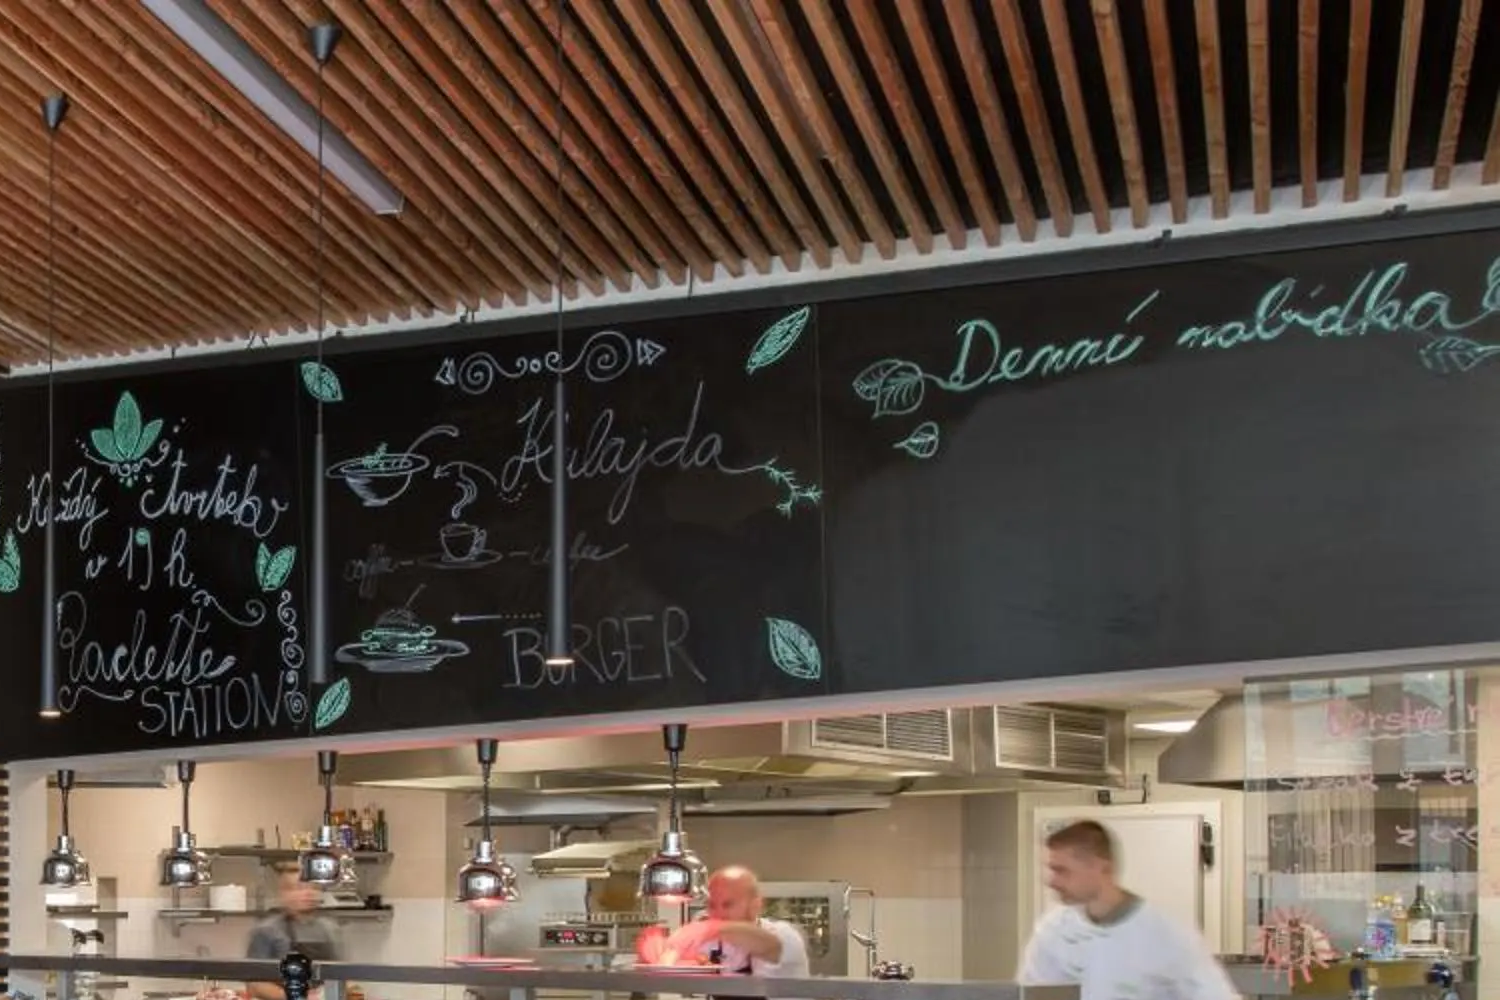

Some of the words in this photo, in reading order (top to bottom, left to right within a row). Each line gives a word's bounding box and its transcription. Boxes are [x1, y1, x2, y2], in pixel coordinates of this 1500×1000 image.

[949, 289, 1159, 392] Denní
[1174, 261, 1460, 349] nabídka
[56, 590, 238, 686] Raclette
[137, 671, 286, 739] STATION
